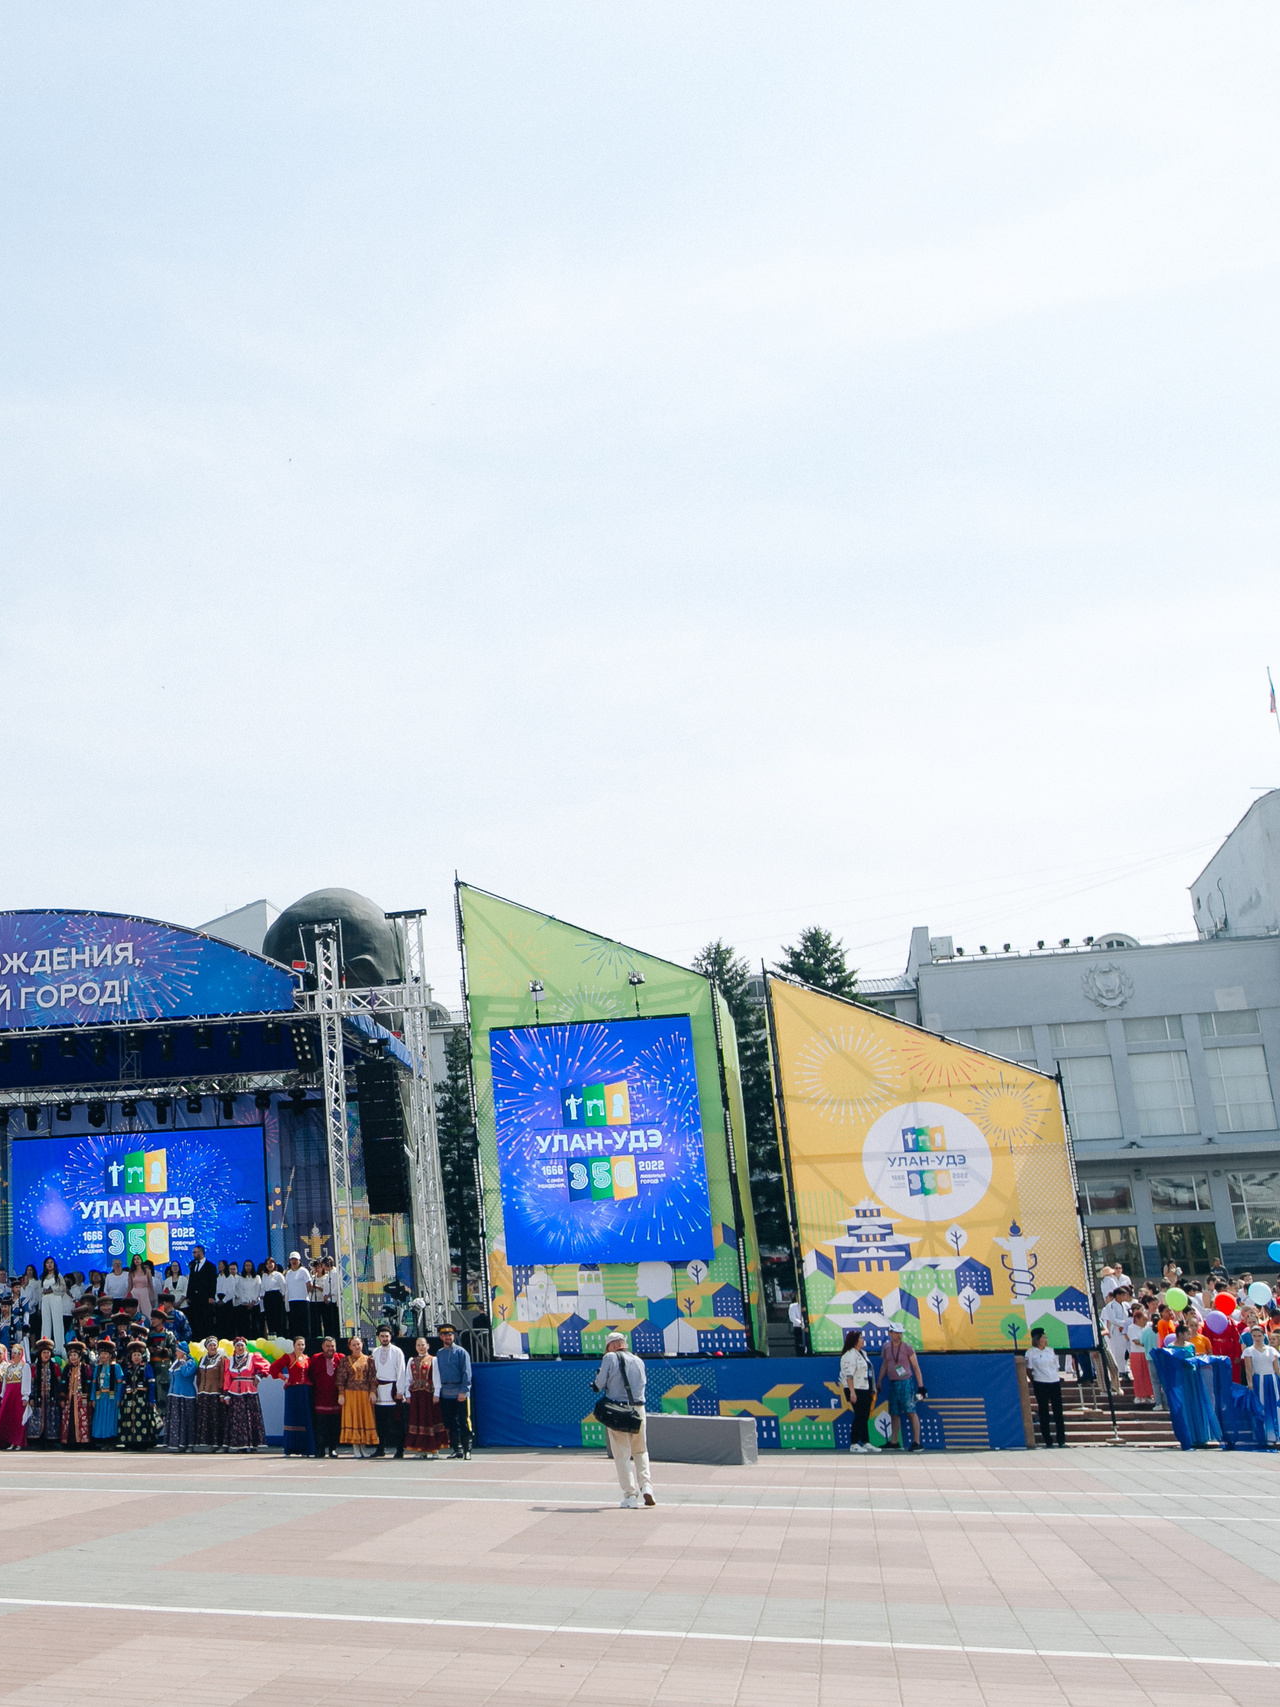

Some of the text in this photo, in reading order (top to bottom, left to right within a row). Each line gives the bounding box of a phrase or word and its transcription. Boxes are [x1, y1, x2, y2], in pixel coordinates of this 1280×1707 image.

[20, 979, 129, 1009] ГОРОД!
[535, 1128, 663, 1153] УЛАН-УДЭ
[541, 1159, 665, 1190] 1666 356 2022
[887, 1154, 967, 1168] УЛАН-УДЭ
[79, 1197, 195, 1219] УЛАН-УДЭ
[82, 1227, 195, 1256] 1666 356 2022
